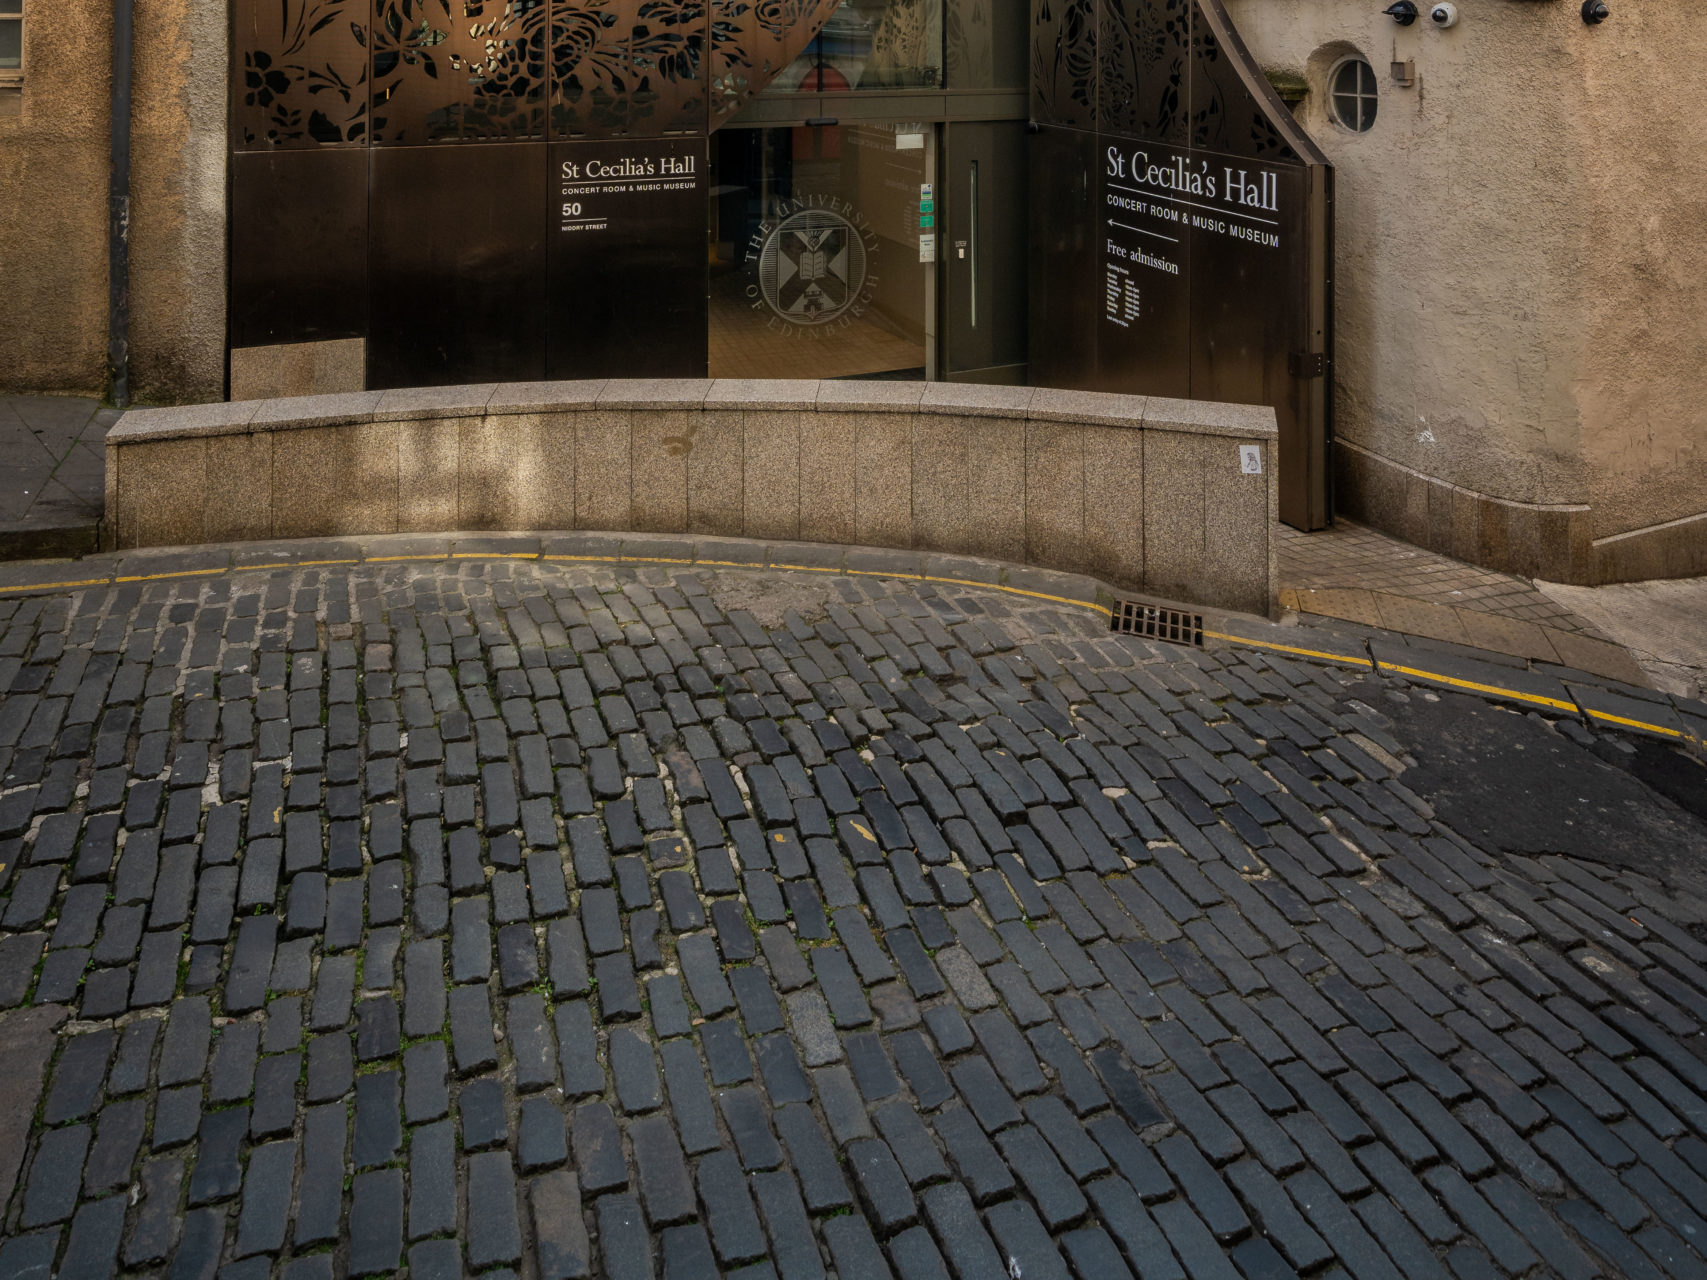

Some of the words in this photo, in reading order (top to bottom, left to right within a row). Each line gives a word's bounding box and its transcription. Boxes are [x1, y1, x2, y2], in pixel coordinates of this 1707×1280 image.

[562, 161, 580, 179] St
[586, 157, 654, 177] Cecilia's
[660, 156, 695, 174] Hall
[1107, 146, 1126, 178] St
[1132, 151, 1216, 198] Cecilia's
[1224, 167, 1278, 212] Hall
[562, 186, 600, 195] CONCERT
[562, 203, 582, 216] 50
[744, 220, 772, 263] THE
[776, 193, 880, 256] UNIVERSITY
[1107, 194, 1147, 213] CONCERT
[1151, 205, 1178, 221] ROOM
[1182, 213, 1189, 224] &
[1193, 216, 1225, 234] MUSIC
[1230, 225, 1279, 248] MUSEUM
[1107, 239, 1127, 258] Free
[1130, 248, 1179, 275] admission
[745, 284, 766, 312] OF
[766, 275, 879, 341] EDINBURGH
